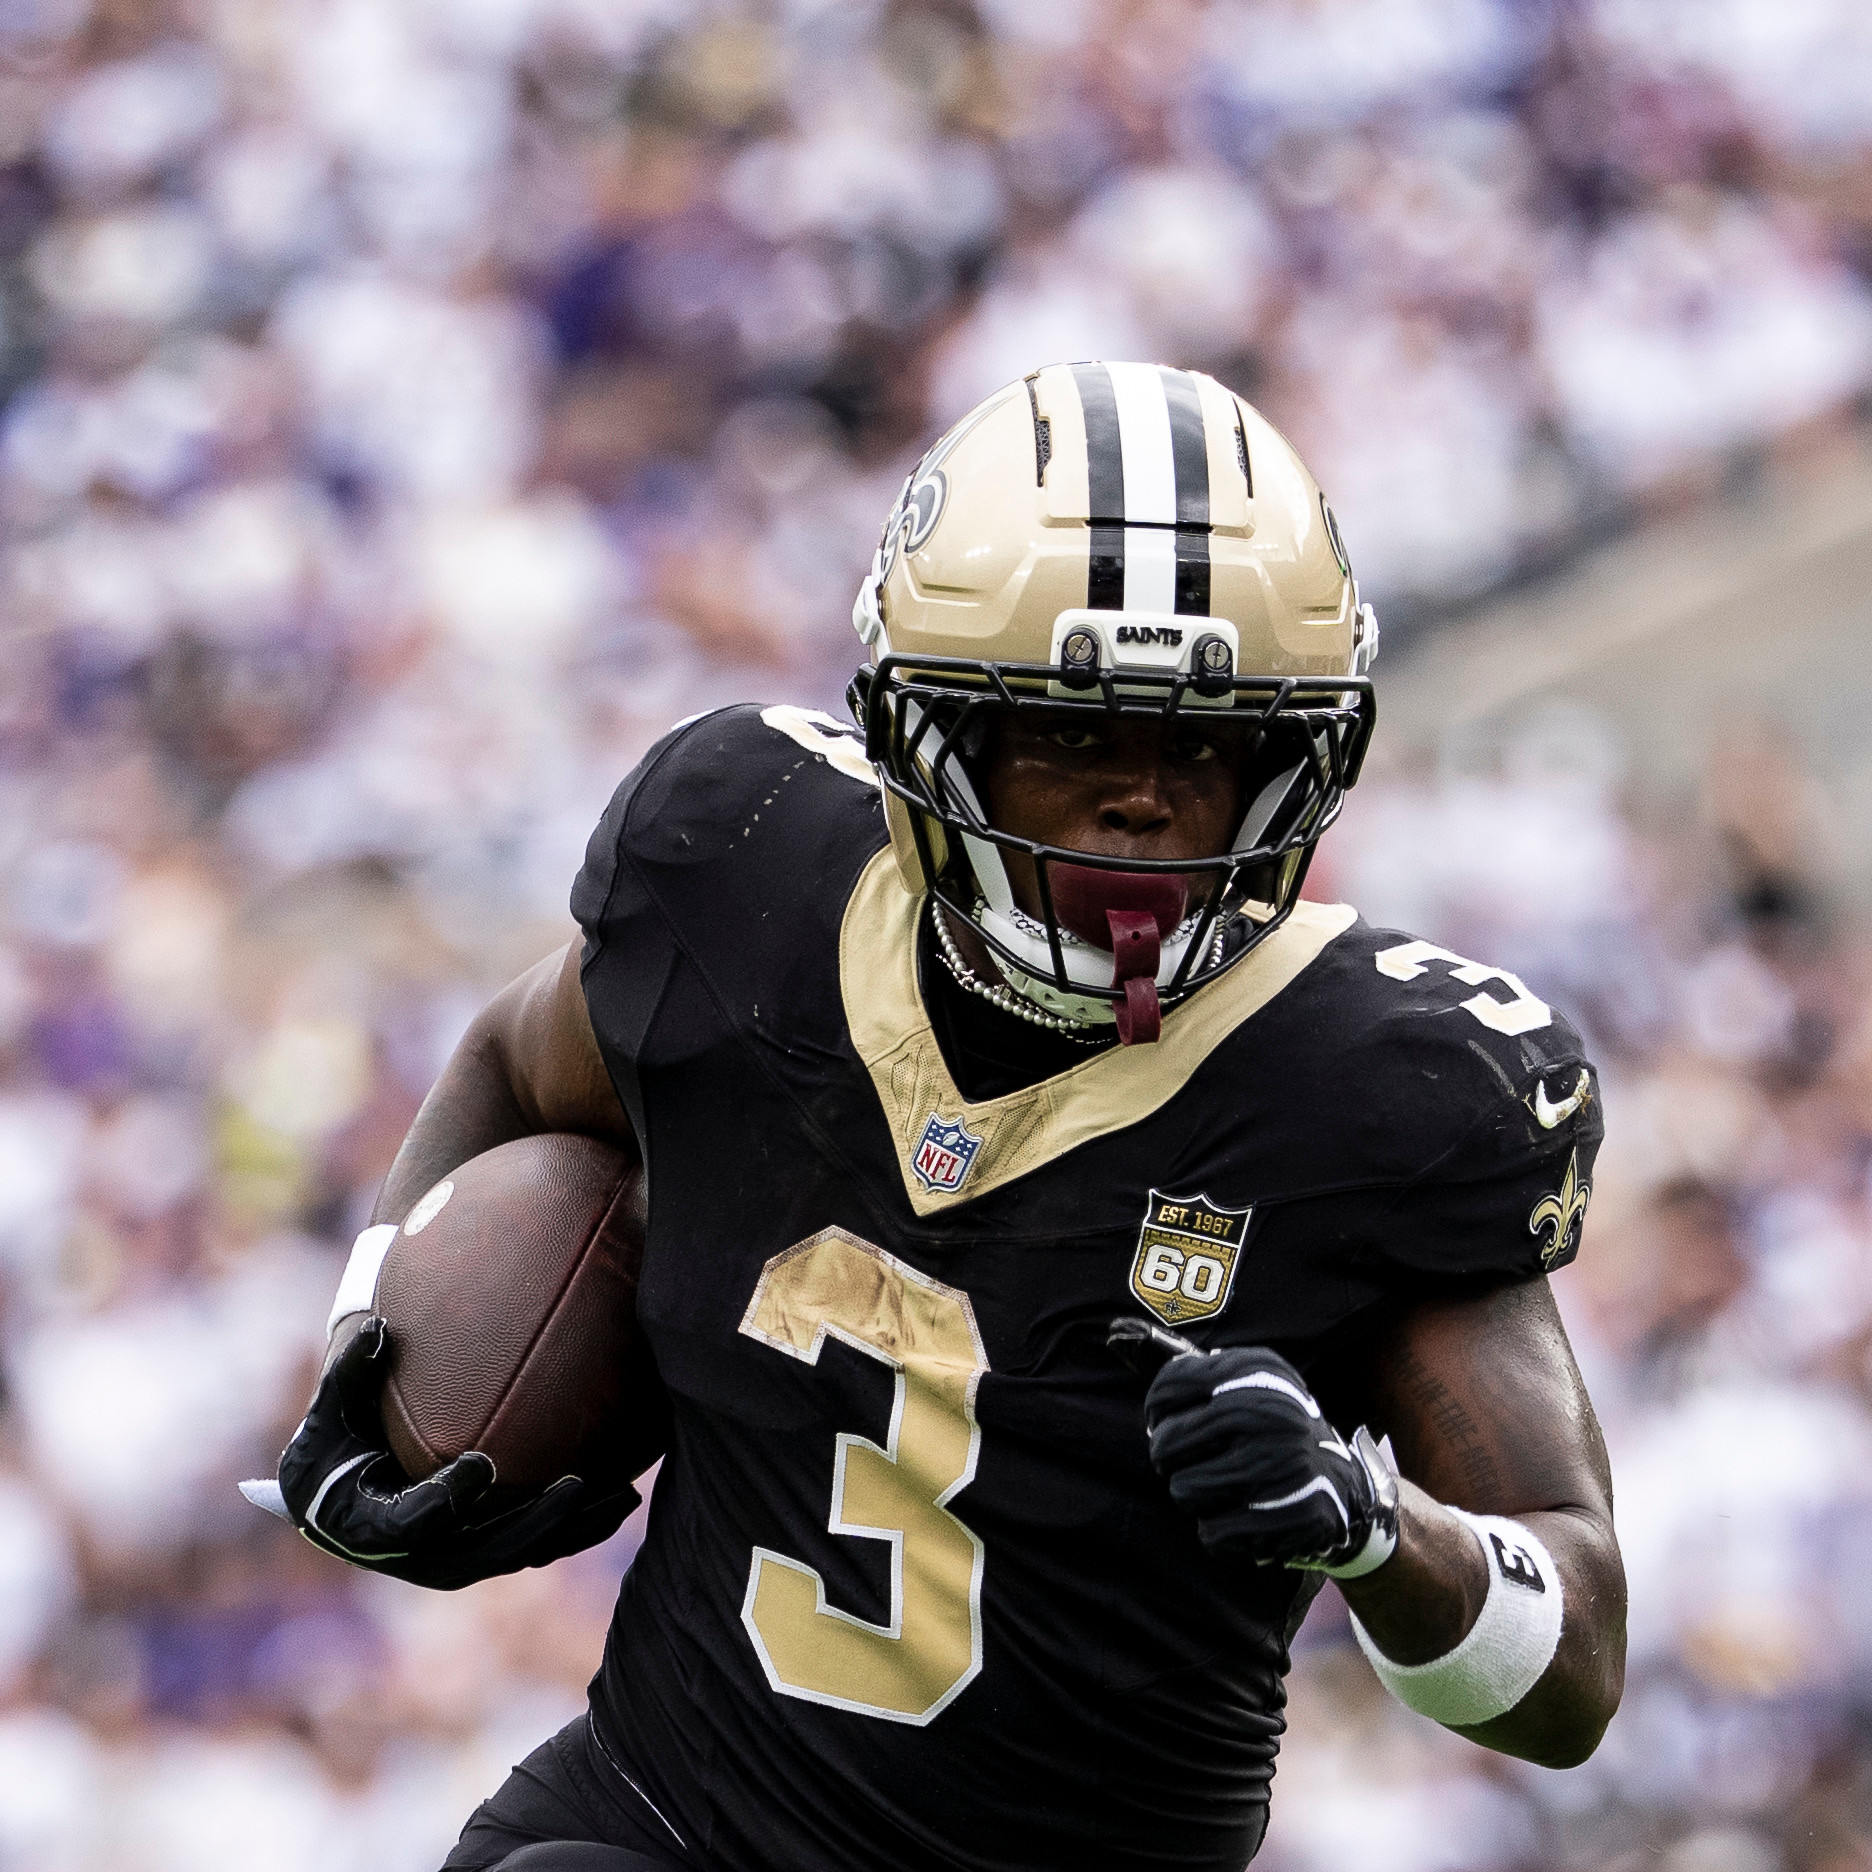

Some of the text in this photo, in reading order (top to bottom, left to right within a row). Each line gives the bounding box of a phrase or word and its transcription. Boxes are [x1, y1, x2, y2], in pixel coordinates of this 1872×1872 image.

[1116, 626, 1183, 647] SAINTS
[1374, 940, 1552, 1036] 3
[917, 1142, 958, 1184] NFL
[1157, 1204, 1234, 1237] EST. 1967
[1139, 1243, 1227, 1304] 60
[738, 1225, 990, 1727] 3
